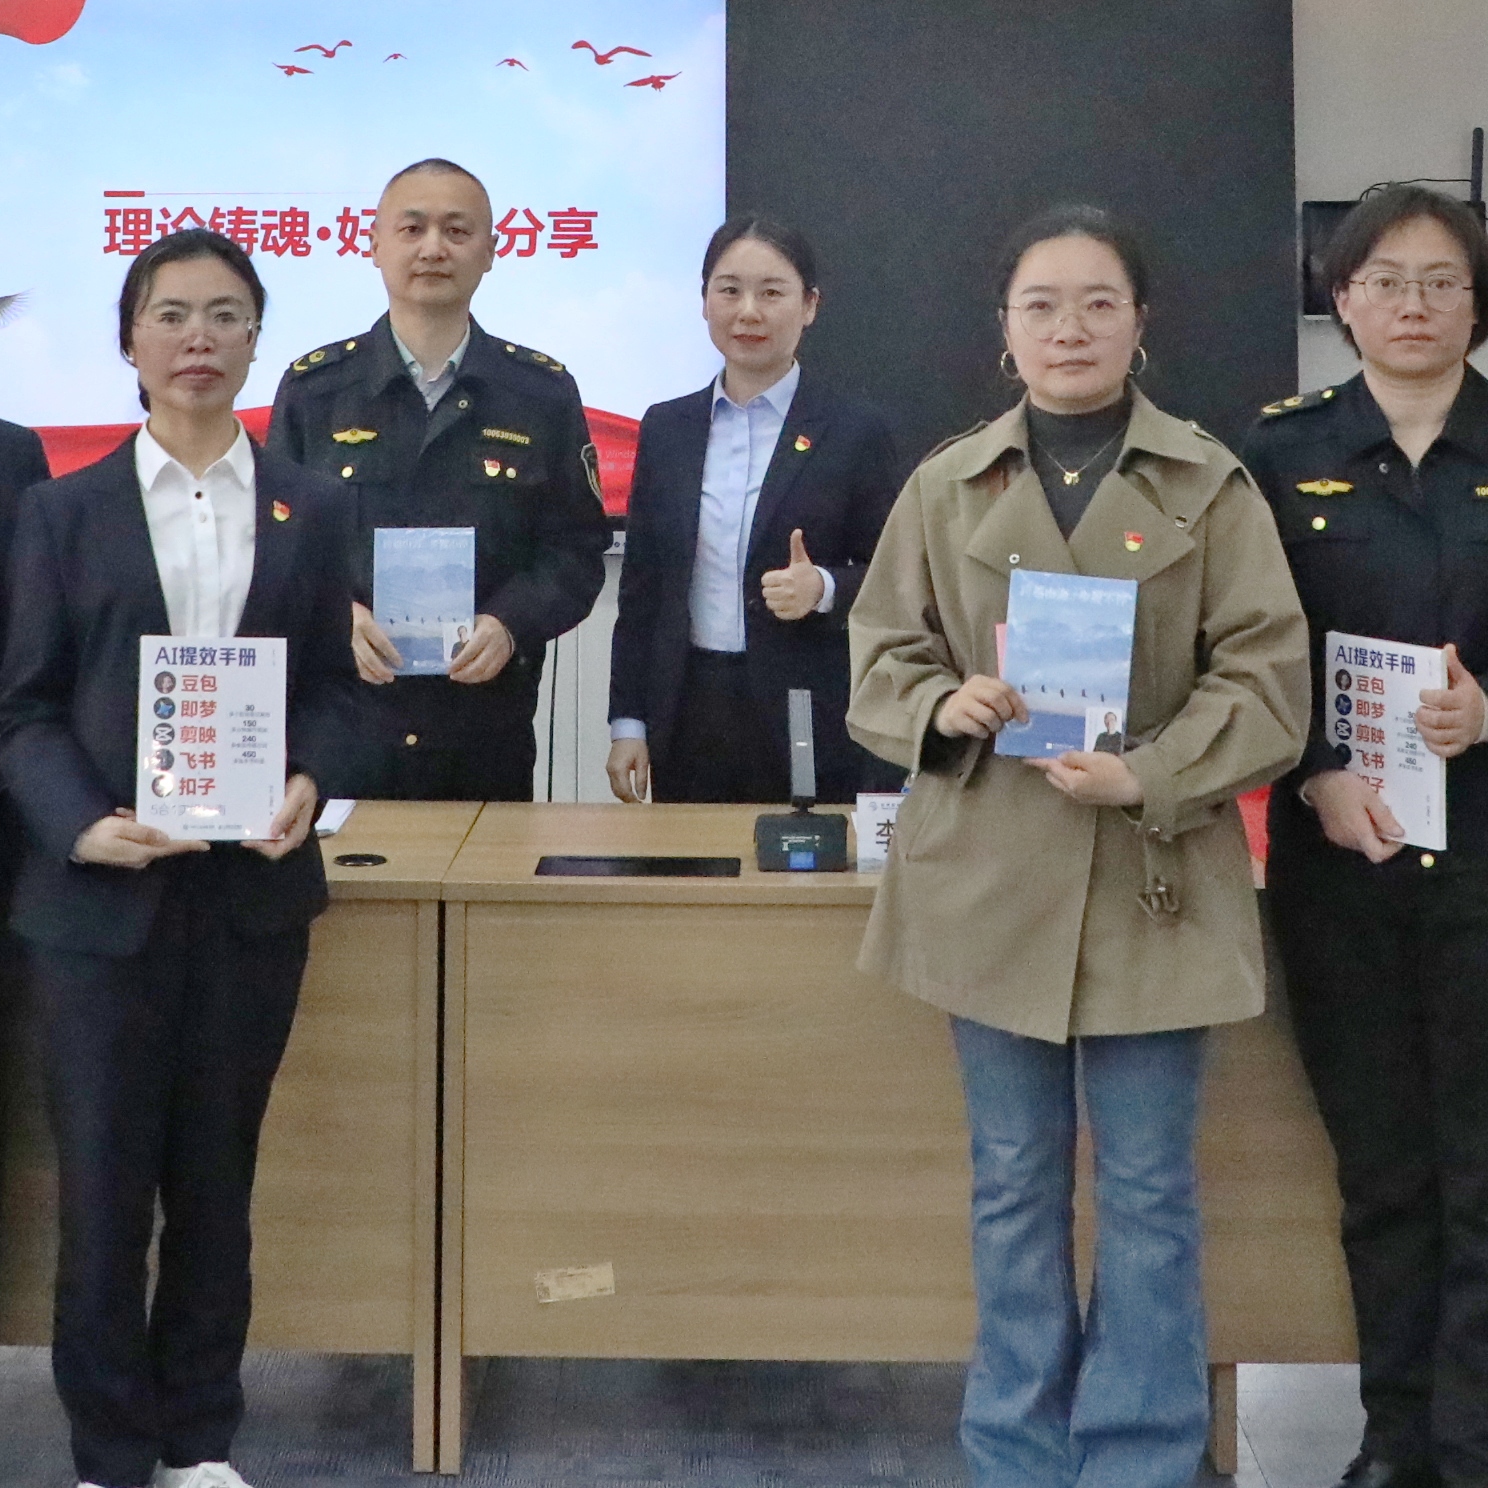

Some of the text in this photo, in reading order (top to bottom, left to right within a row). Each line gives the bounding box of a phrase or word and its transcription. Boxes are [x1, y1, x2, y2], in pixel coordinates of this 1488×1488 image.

[103, 206, 598, 258] 理论铸魂·好分享
[155, 646, 256, 667] AI提效手册
[1335, 645, 1416, 675] AI提效手册
[181, 674, 218, 692] 豆包
[1356, 675, 1385, 695] 豆包
[181, 700, 217, 718] 即梦
[1356, 699, 1386, 719] 即梦
[180, 726, 217, 744] 剪映
[1356, 724, 1385, 745] 剪映
[179, 752, 216, 769] 飞书
[1356, 749, 1384, 769] 飞书
[179, 778, 216, 795] 扣子
